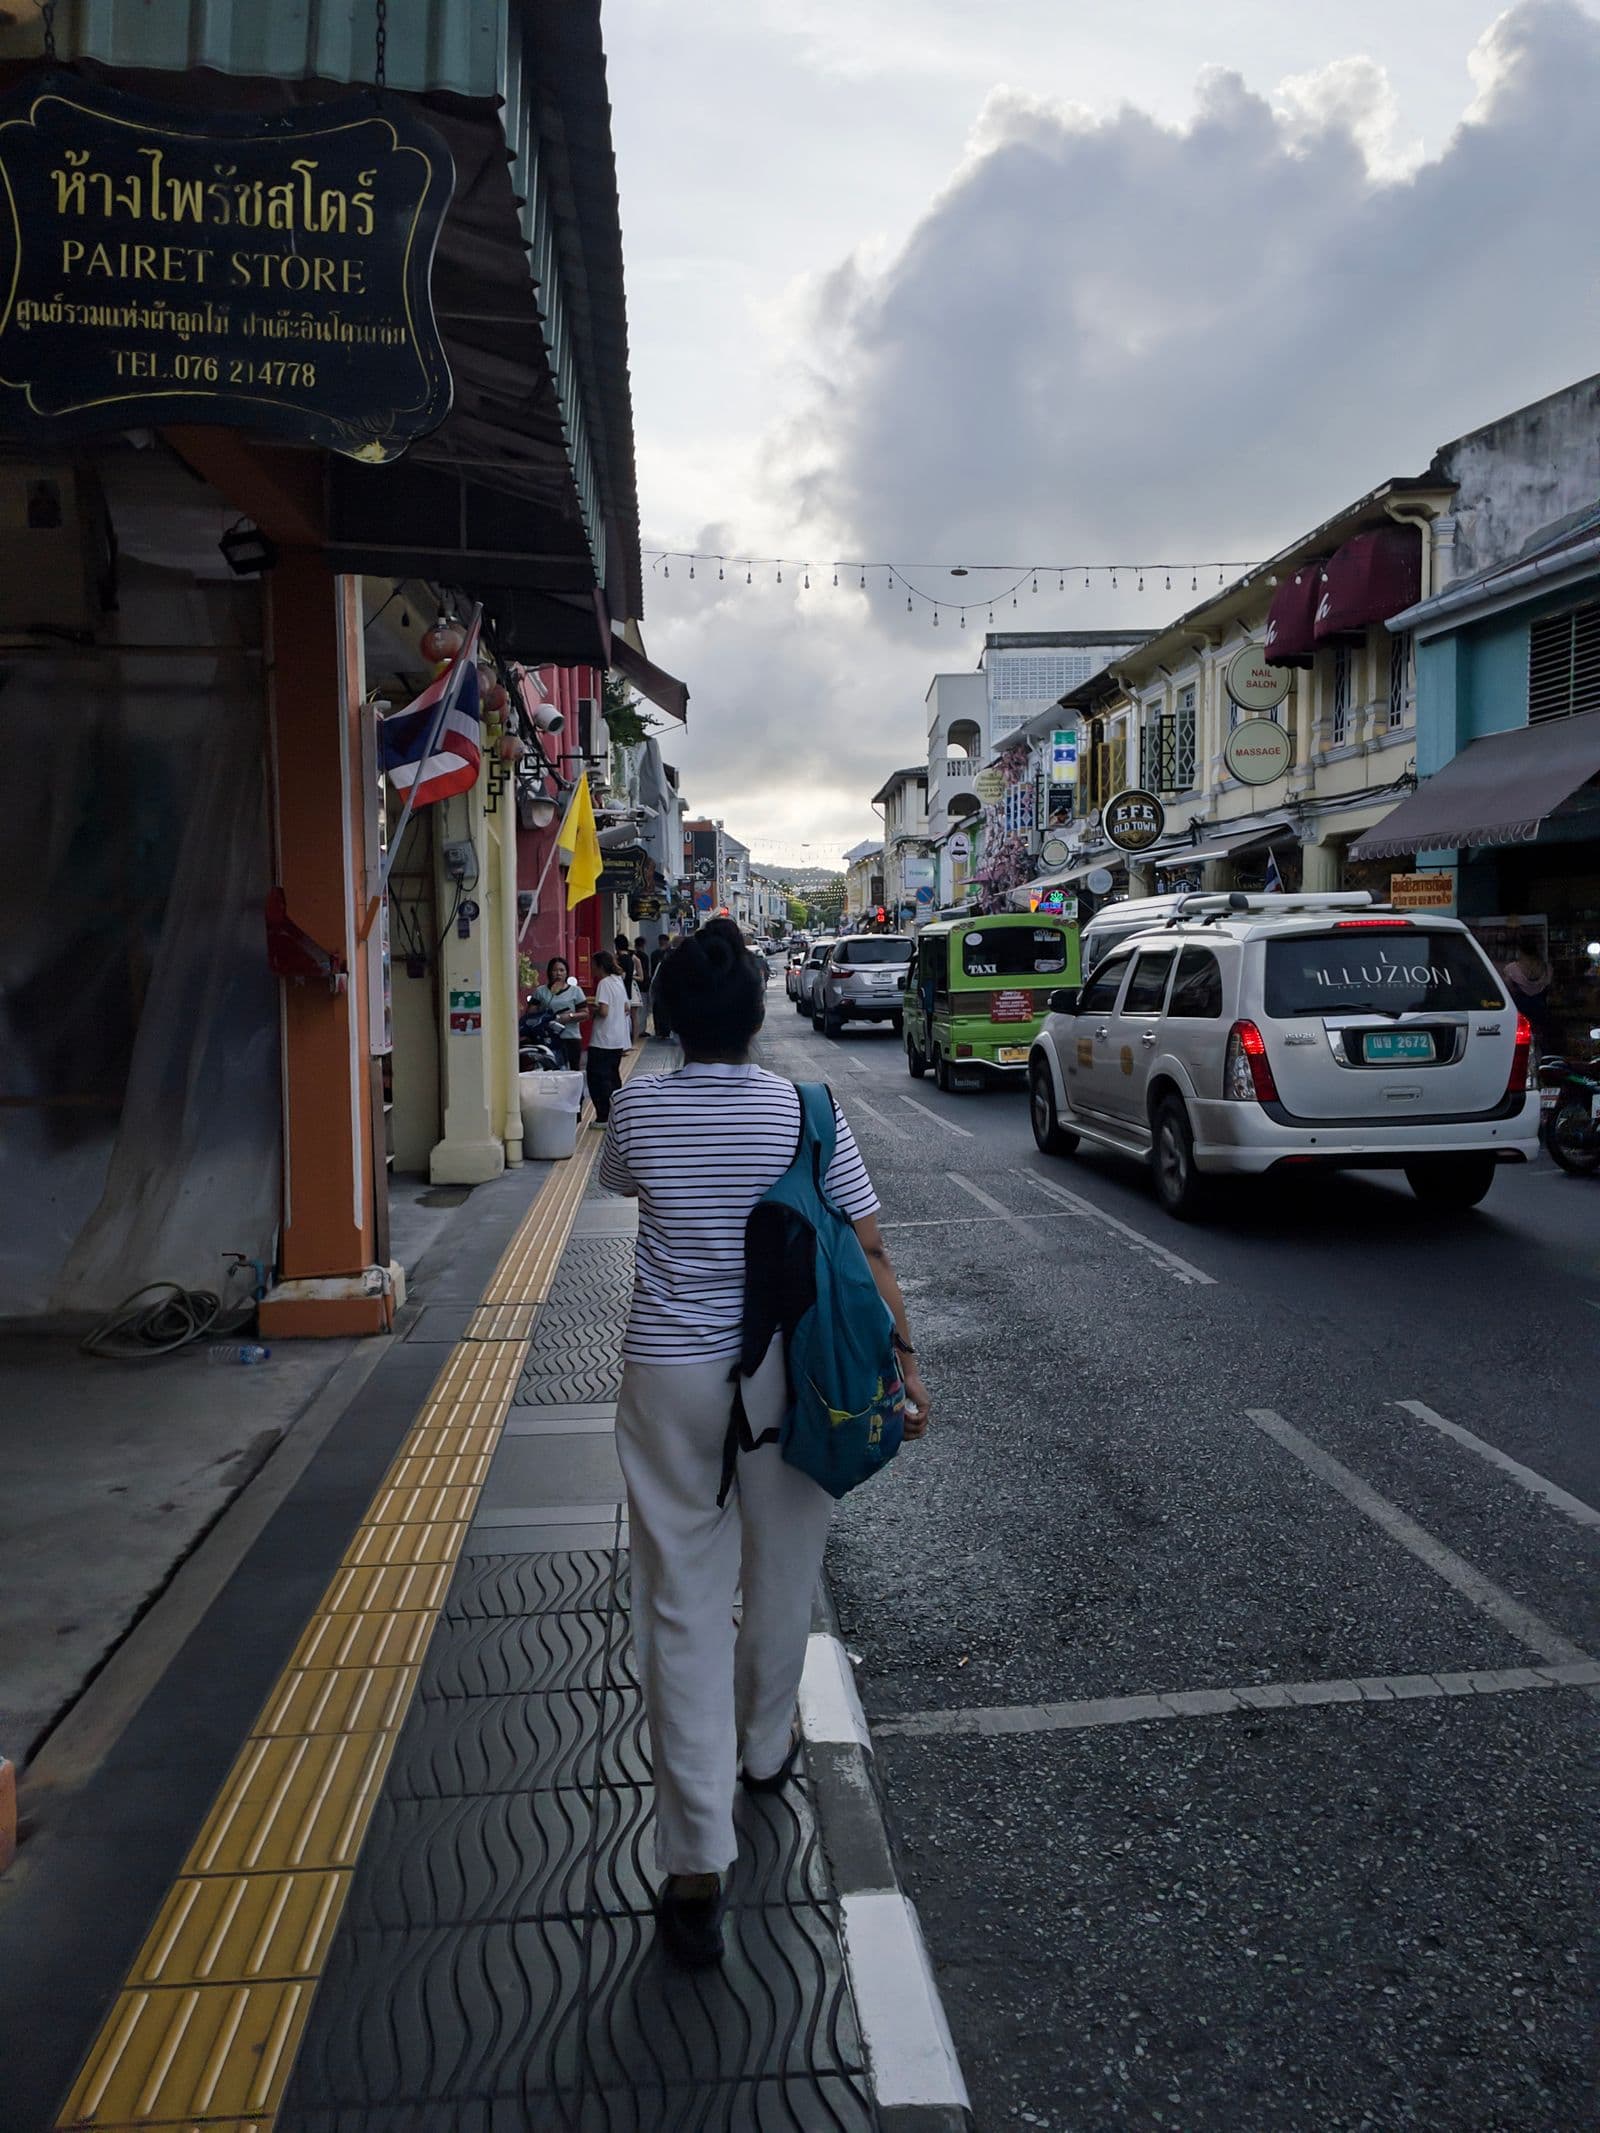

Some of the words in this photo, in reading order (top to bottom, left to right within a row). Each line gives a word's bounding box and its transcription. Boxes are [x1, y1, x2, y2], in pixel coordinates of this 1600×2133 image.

[50, 147, 377, 237] ห้างไพรัชสโตร์
[61, 239, 215, 285] PAIRET
[230, 250, 367, 296] STORE
[229, 359, 316, 389] 214778
[1251, 669, 1273, 678] NAIL
[1246, 680, 1278, 689] SALON
[1235, 747, 1281, 757] MASSAGE
[1117, 804, 1154, 821] EFE
[1113, 822, 1130, 834] OLD
[1131, 821, 1157, 833] TOWN
[968, 963, 997, 975] TAXI
[1316, 962, 1452, 986] ILLUZION
[1397, 1035, 1428, 1049] 2672
